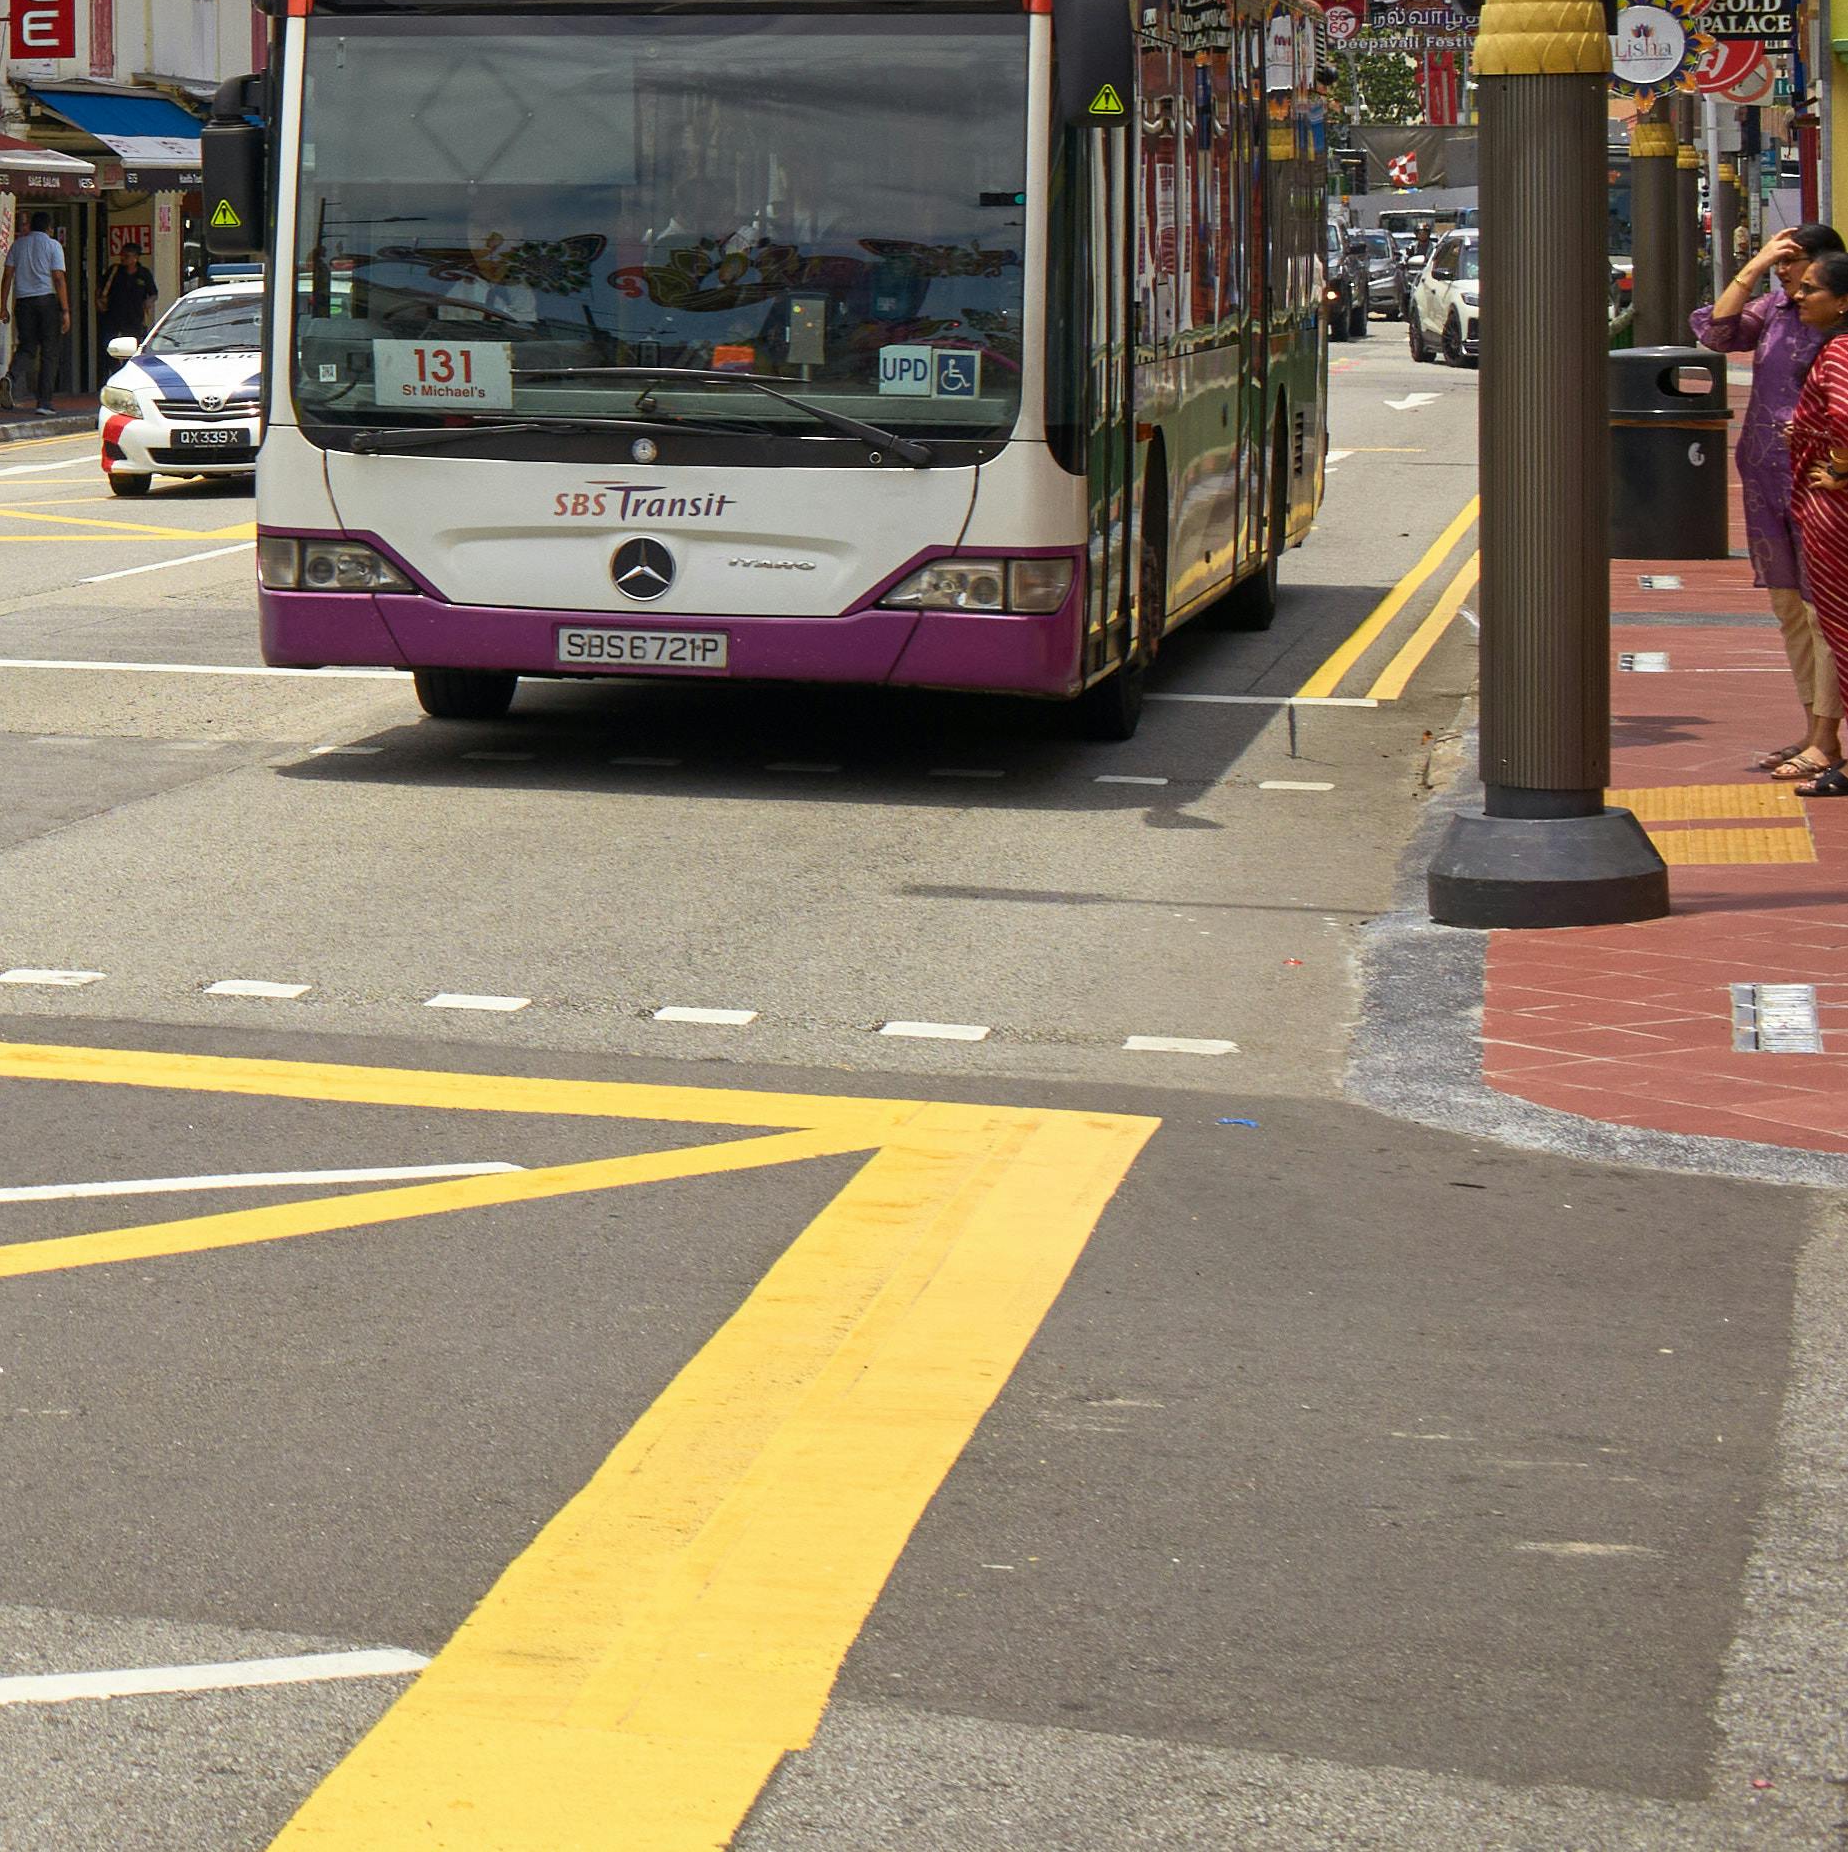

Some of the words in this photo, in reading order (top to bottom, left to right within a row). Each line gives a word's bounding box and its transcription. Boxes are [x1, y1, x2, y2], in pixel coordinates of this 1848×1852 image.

[1697, 14, 1793, 34] PALACE
[1614, 36, 1672, 58] Lisha
[414, 348, 472, 384] 131
[883, 357, 928, 382] UPD
[402, 383, 416, 396] St
[421, 384, 486, 398] Michael's
[553, 492, 608, 518] SBS
[604, 485, 739, 522] Transit
